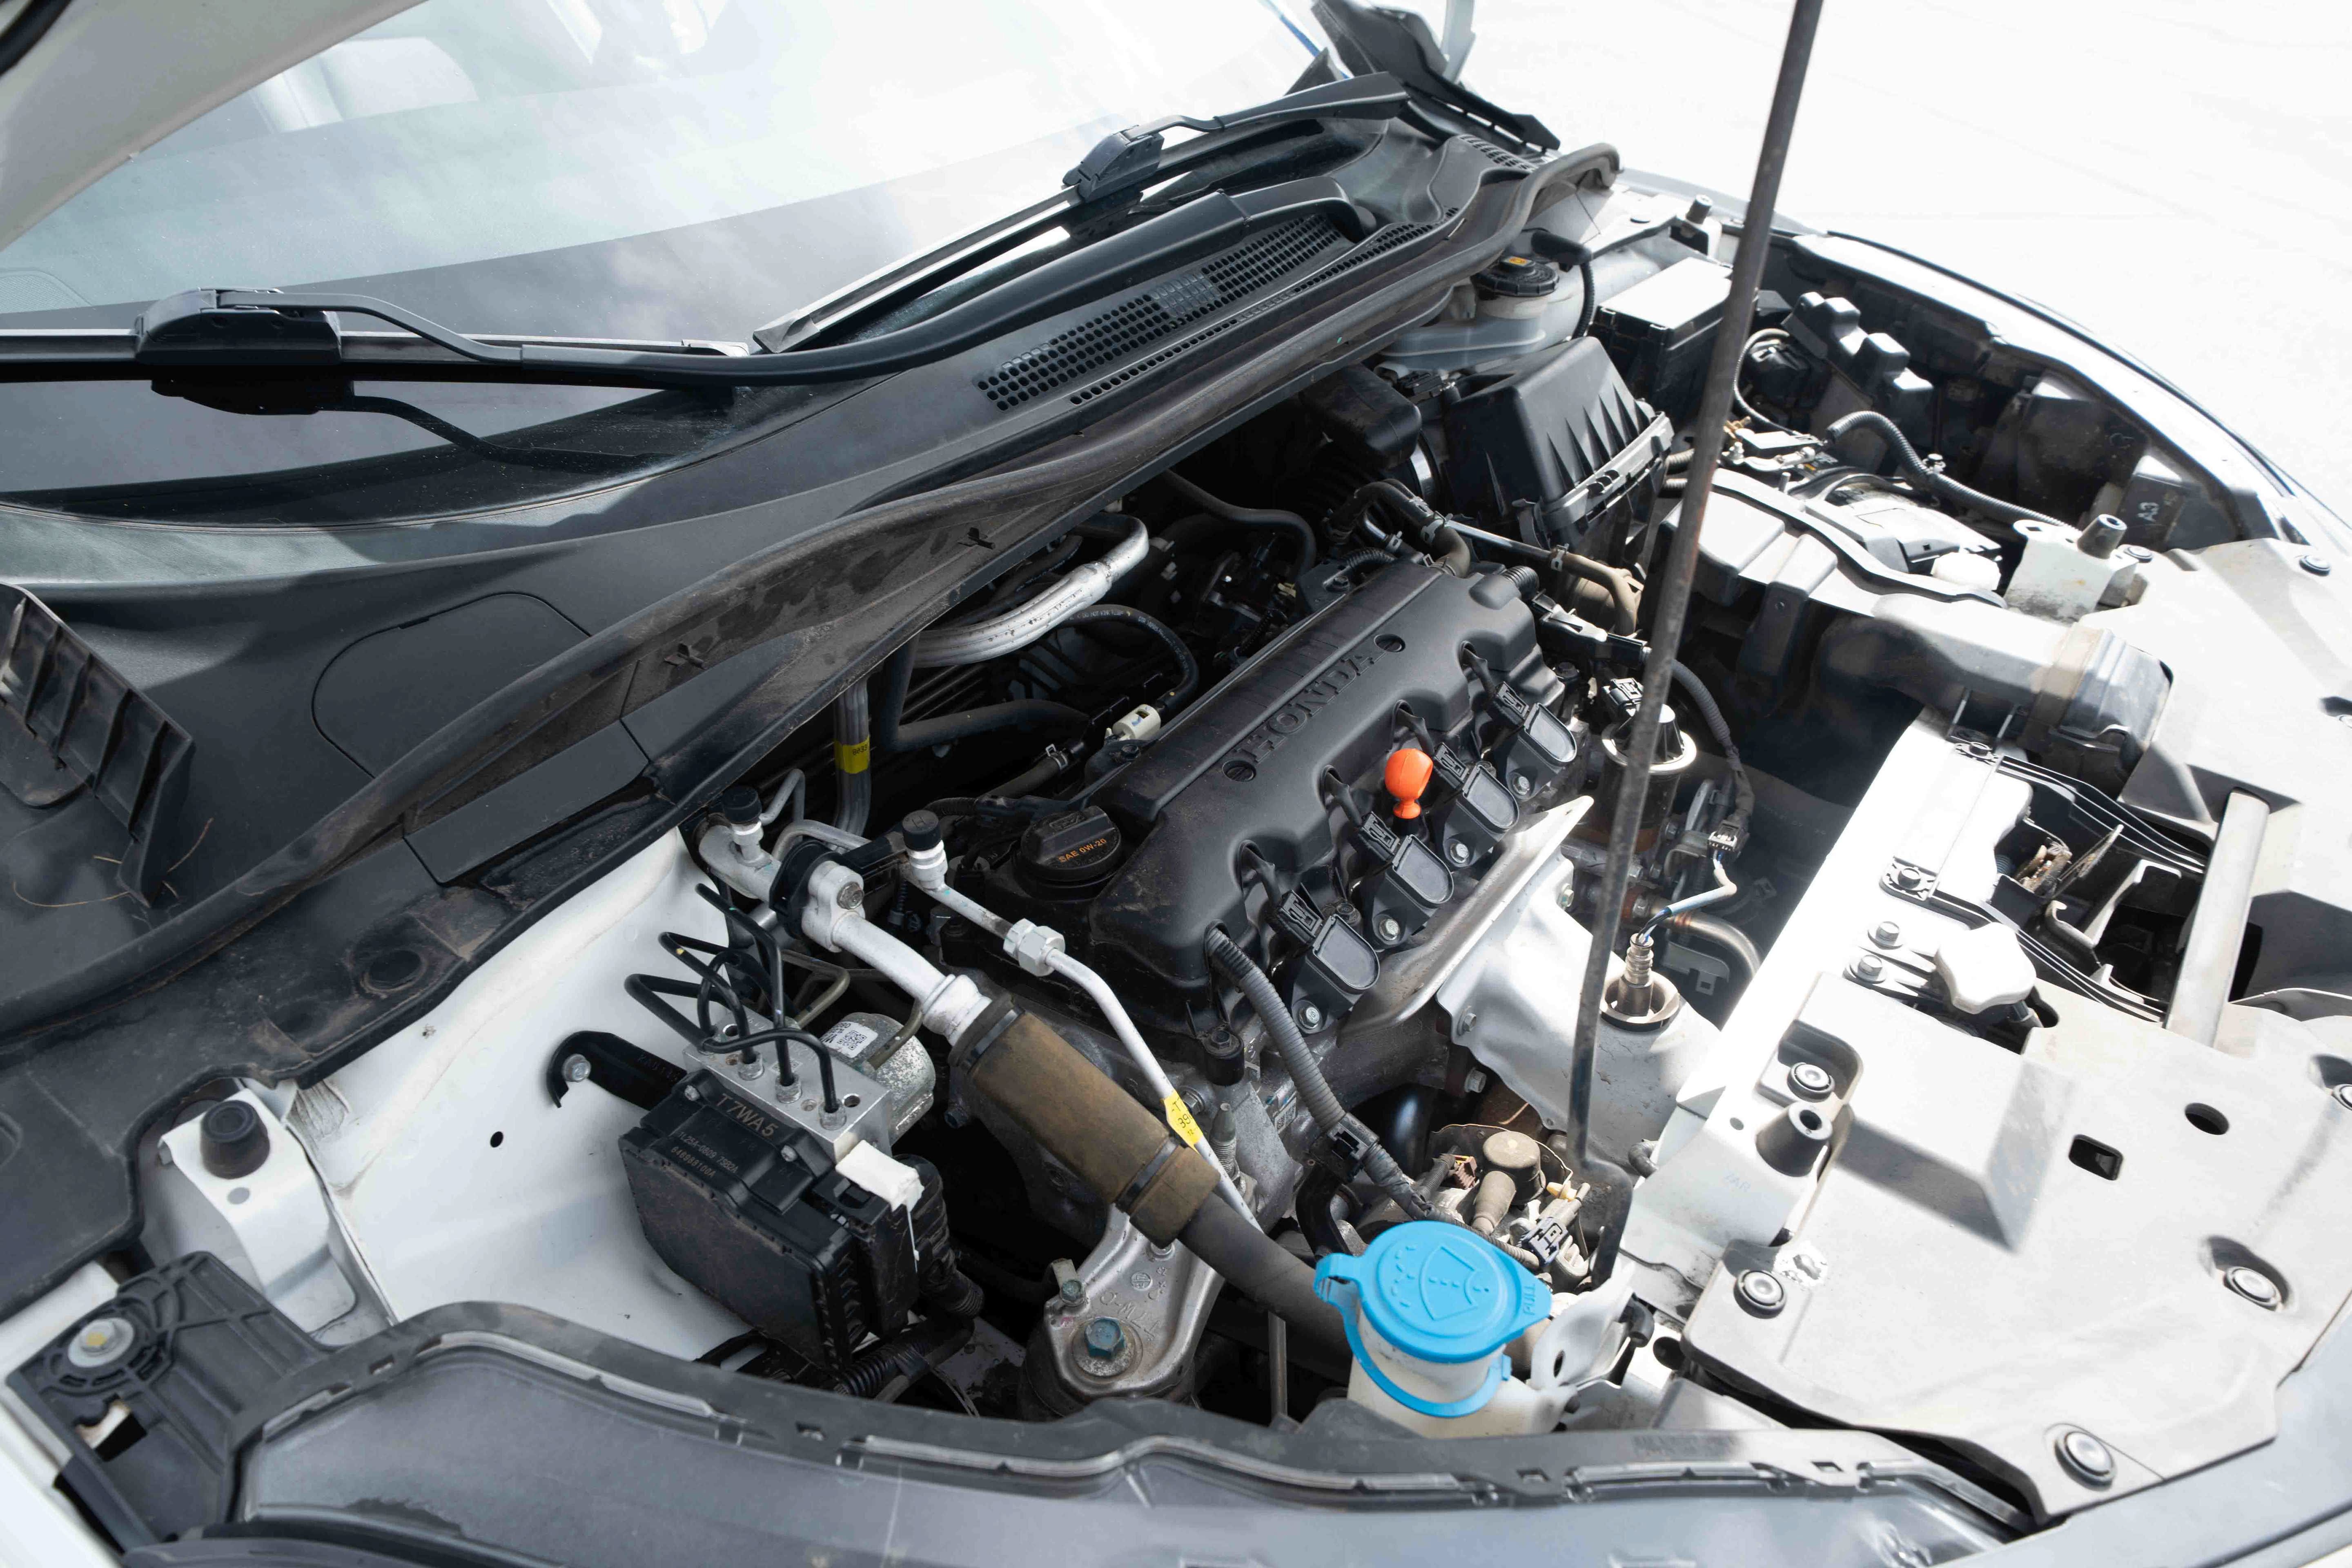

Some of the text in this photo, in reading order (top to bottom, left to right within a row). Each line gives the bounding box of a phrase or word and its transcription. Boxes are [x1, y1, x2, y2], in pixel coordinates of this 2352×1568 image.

[1236, 653, 1386, 764] HONDA
[1058, 838, 1107, 863] SAE 0W-20
[1522, 1282, 1536, 1316] PULL
